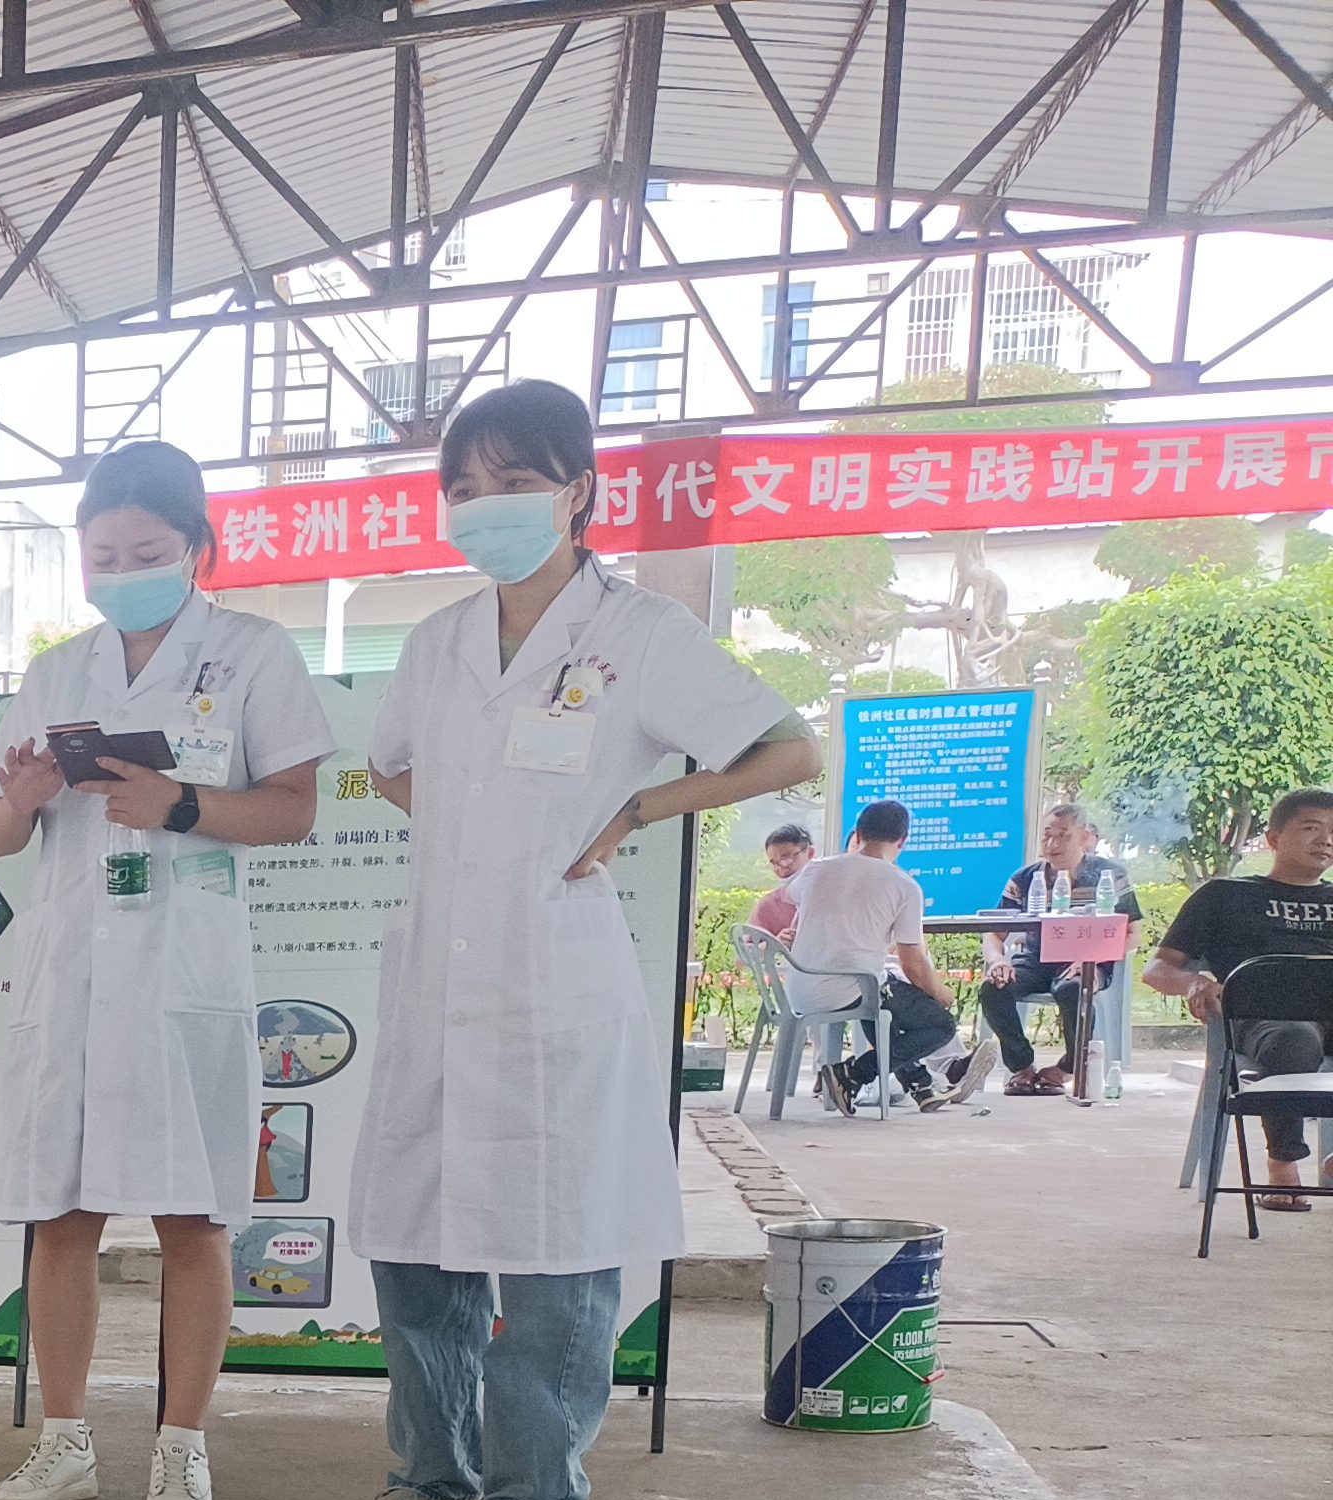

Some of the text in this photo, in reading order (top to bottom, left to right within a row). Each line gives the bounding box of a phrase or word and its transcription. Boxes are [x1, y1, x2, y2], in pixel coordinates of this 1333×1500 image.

[1051, 924, 1118, 940] 签到台
[892, 1330, 923, 1347] FLOOR
